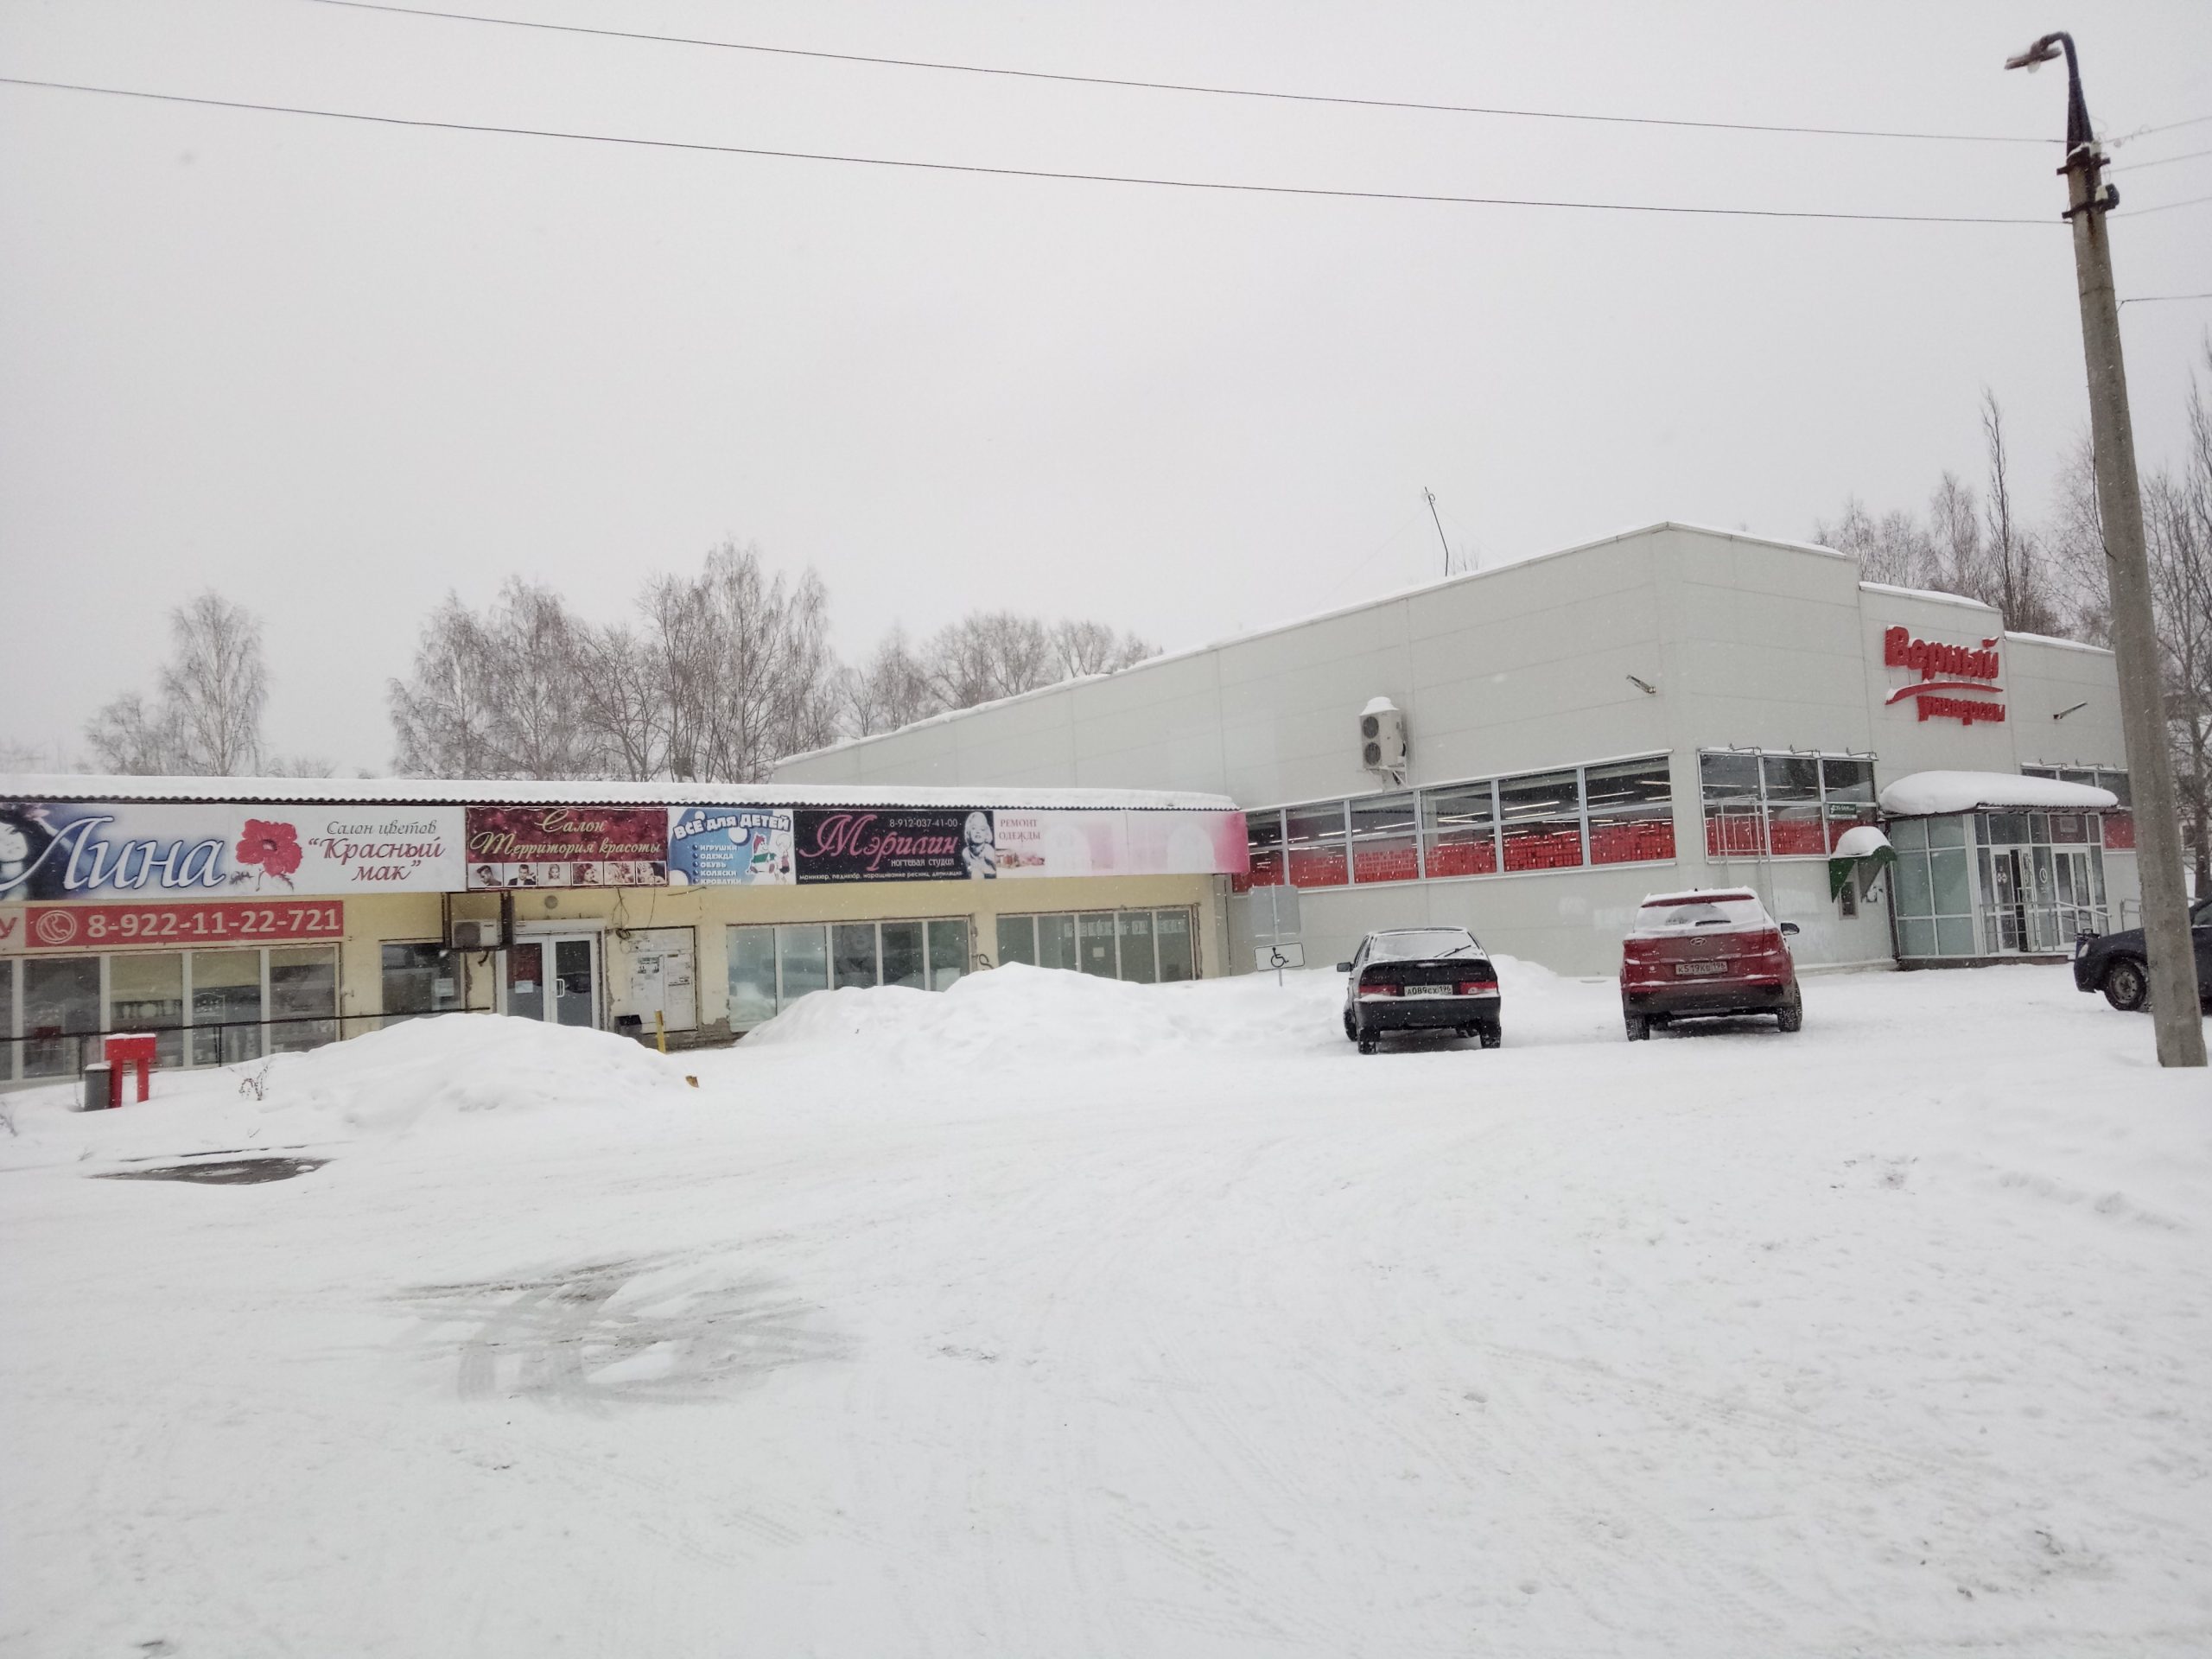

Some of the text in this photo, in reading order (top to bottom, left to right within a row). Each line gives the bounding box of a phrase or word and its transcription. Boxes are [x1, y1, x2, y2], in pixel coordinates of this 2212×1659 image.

[1885, 626, 1999, 680] Верный
[327, 819, 437, 836] Салон цветов
[534, 808, 605, 833] Салон
[673, 819, 705, 840] ВСЕ
[740, 813, 791, 832] ДЕТЕЙ
[889, 818, 958, 828] 8-912-037-41-00
[1000, 818, 1038, 828] РЕМОНТ
[469, 831, 661, 860] Территория красоты
[798, 814, 960, 872] Мэрилин
[999, 831, 1040, 842] ОДЕЖДЫ
[0, 816, 226, 891] Лина
[87, 908, 340, 938] 8-922-11-22-721
